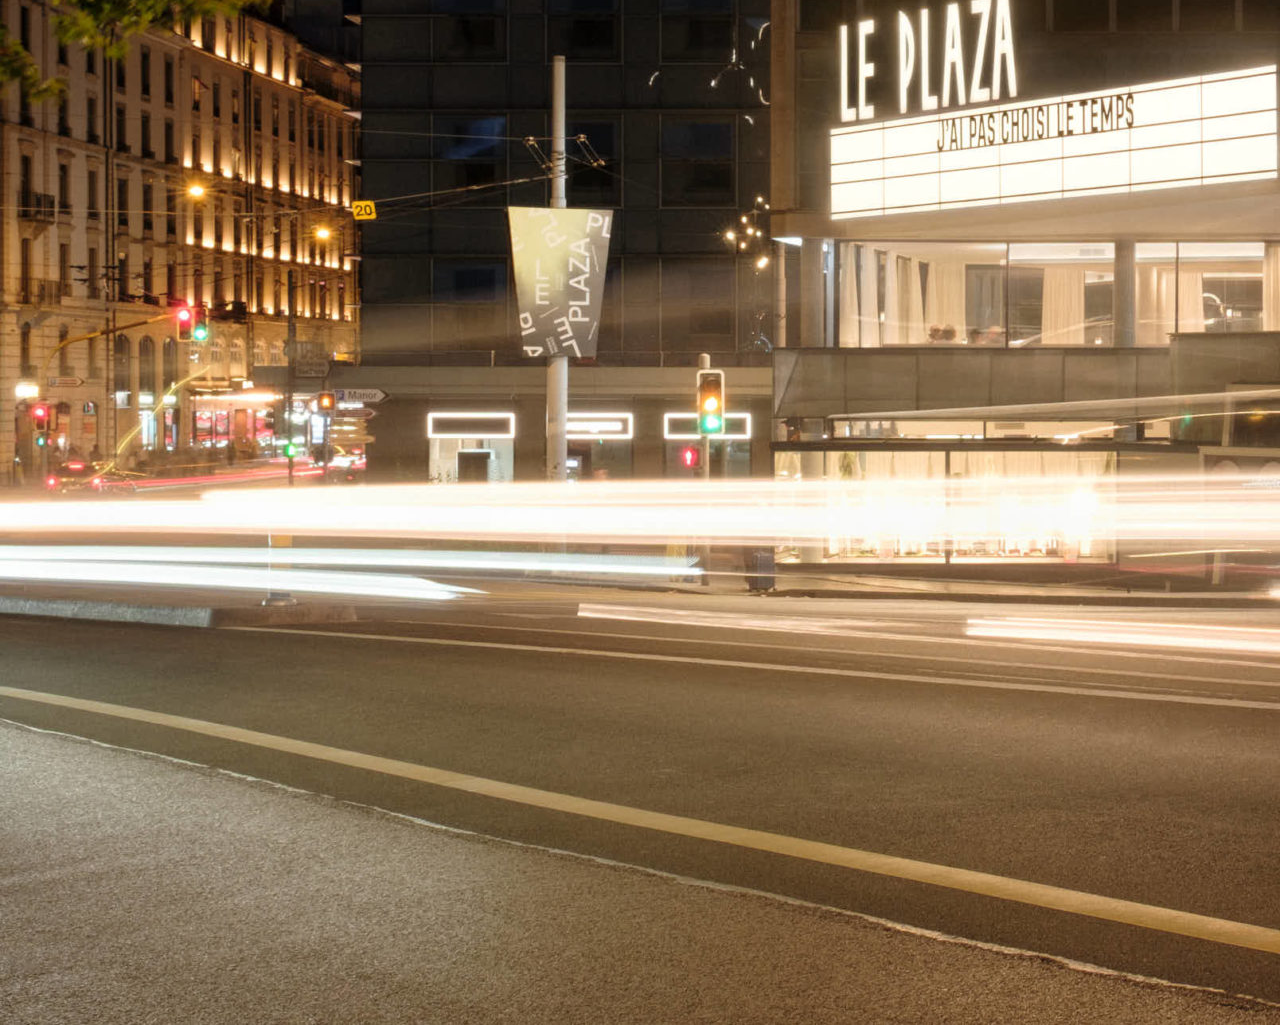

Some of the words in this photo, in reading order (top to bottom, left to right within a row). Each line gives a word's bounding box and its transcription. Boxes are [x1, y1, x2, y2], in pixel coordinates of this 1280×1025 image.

[840, 19, 875, 123] LE
[937, 117, 963, 152] J'AI
[969, 112, 995, 148] PAS
[1001, 104, 1050, 144] CHOISI
[1057, 101, 1074, 137] LE
[1080, 92, 1135, 134] TEMPS
[354, 204, 373, 217] 20
[568, 237, 591, 322] PLAZA
